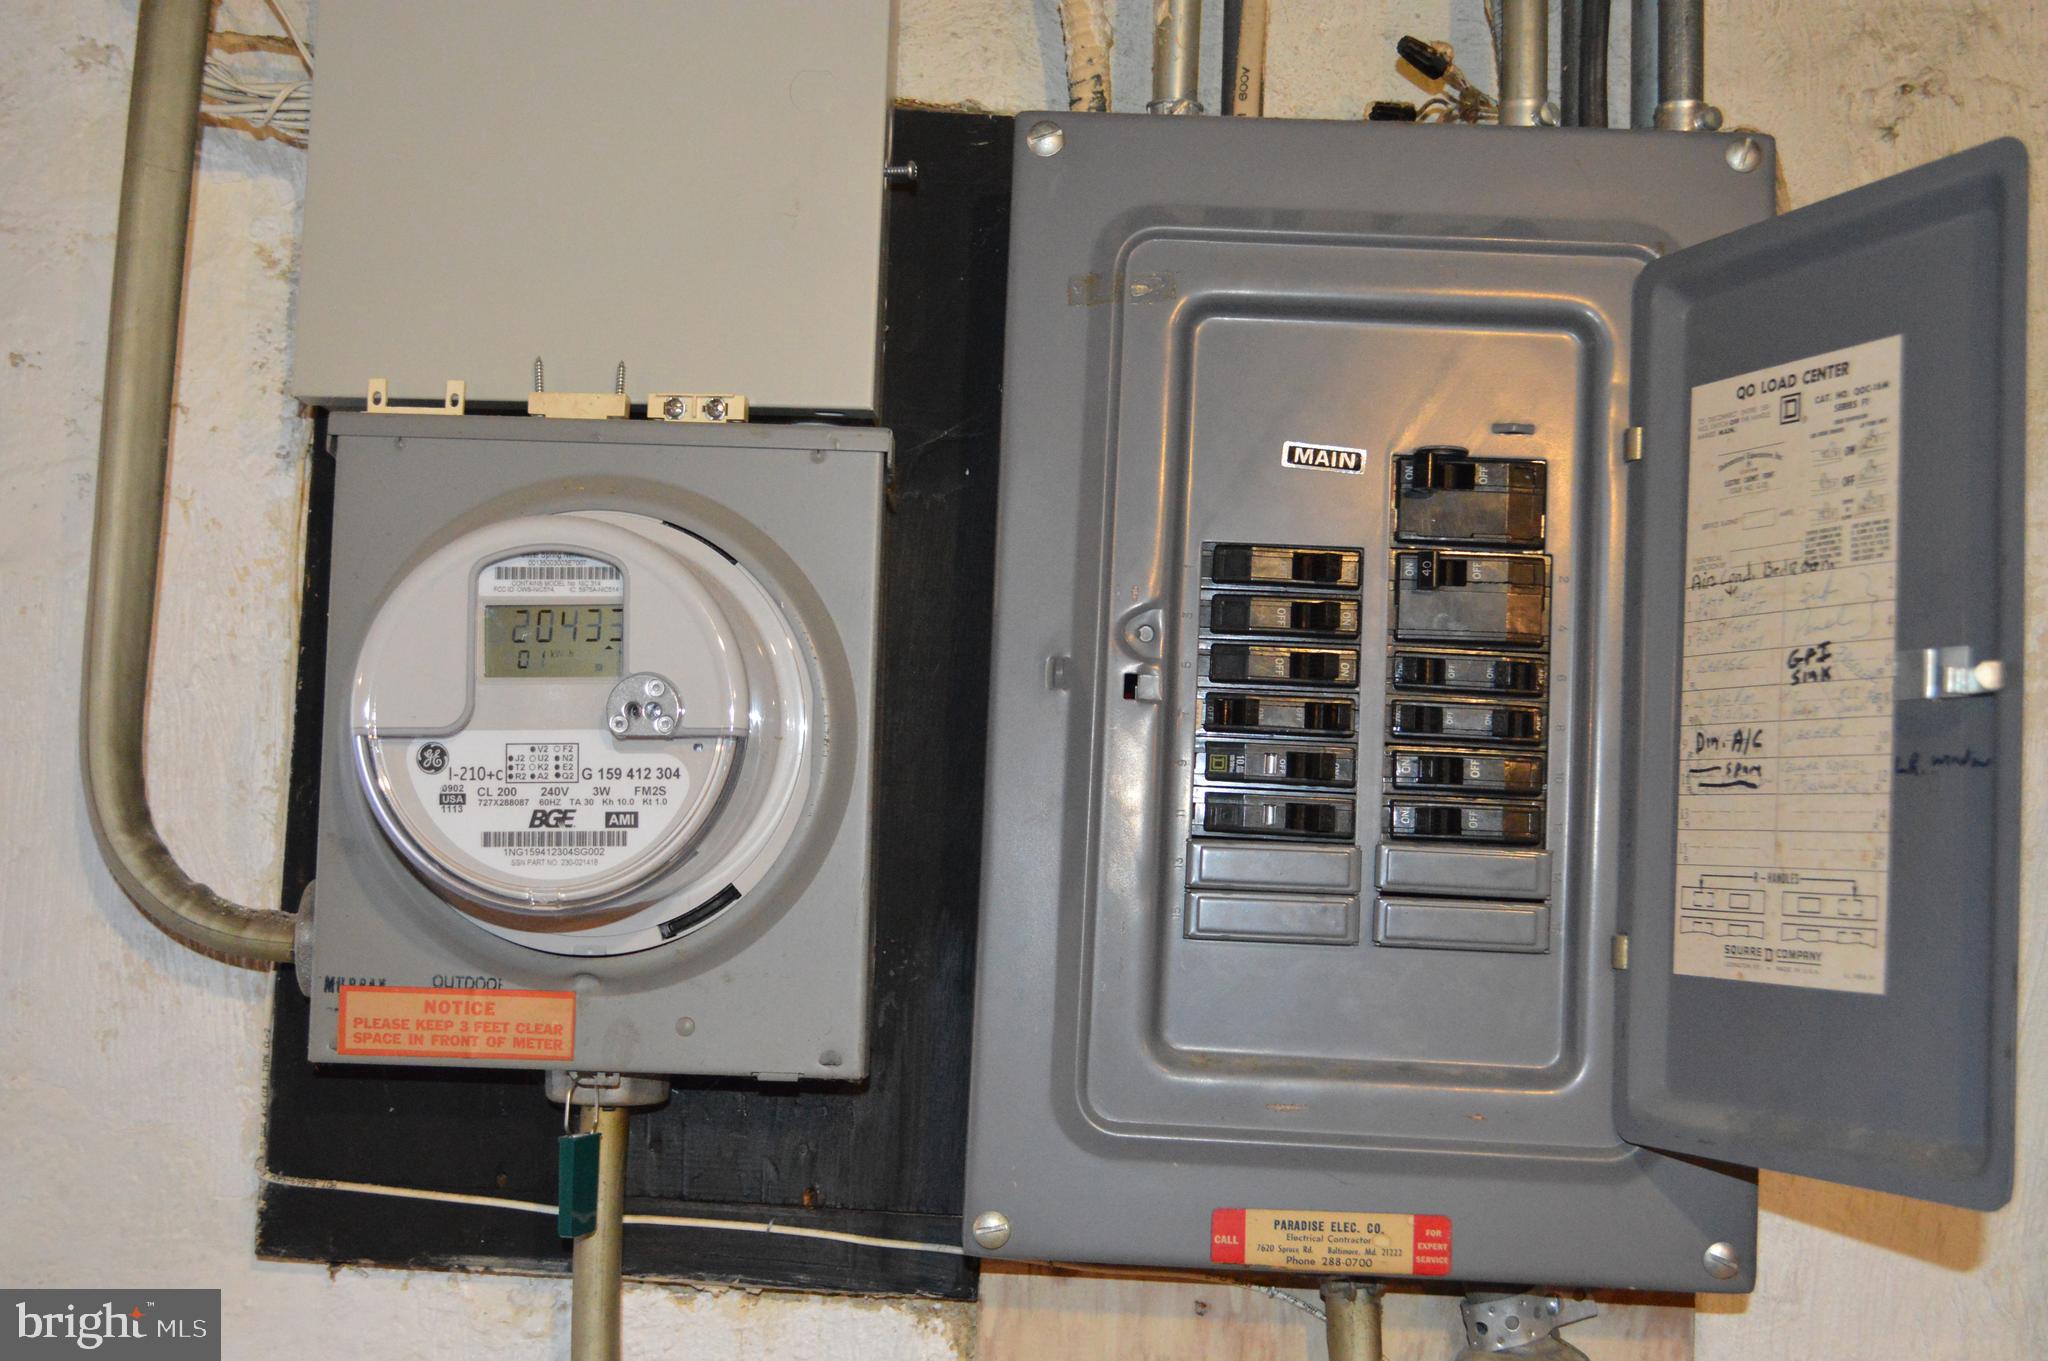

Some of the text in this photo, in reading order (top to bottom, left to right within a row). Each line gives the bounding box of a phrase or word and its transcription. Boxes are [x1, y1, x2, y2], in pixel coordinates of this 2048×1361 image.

[1736, 362, 1850, 400] QO LOAD CENTER
[1293, 447, 1356, 469] MAIN
[1405, 465, 1489, 485] ON OFF
[1405, 560, 1482, 580] ON 40 OFF
[1276, 608, 1350, 627] OFF ON
[1274, 658, 1350, 678] OFF ON
[1448, 664, 1456, 678] OFF
[1486, 667, 1494, 679] ON
[1446, 712, 1454, 725] OFF
[1484, 713, 1492, 726] ON
[582, 767, 680, 780] G 159 412 304
[1401, 758, 1480, 778] ON OFF
[442, 784, 464, 792] 0902
[477, 786, 667, 797] CL 200 240V 3W FM2S
[442, 795, 464, 804] USA
[442, 806, 464, 814] 1113
[528, 808, 576, 828] BGE
[608, 814, 635, 826] AMI
[1400, 810, 1478, 829] ON OFF
[504, 848, 605, 856] 1NG159412304SG002
[1776, 948, 1822, 961] COMPANY
[424, 1000, 496, 1016] NOTICE
[353, 1017, 563, 1036] PLEASE KEEP 3 FEET CLEAR
[353, 1033, 563, 1051] SPACE IN FRONT OF METER
[1274, 1219, 1384, 1234] PARADISE ELEC. CO.
[1425, 1229, 1442, 1237] FOR
[1214, 1235, 1238, 1245] CALL
[1286, 1233, 1371, 1244] Electrical Contractor
[1256, 1244, 1274, 1252] 7620
[1417, 1242, 1448, 1250] EXPERT
[1286, 1256, 1316, 1265] Phone
[1416, 1256, 1449, 1264] SERVICE
